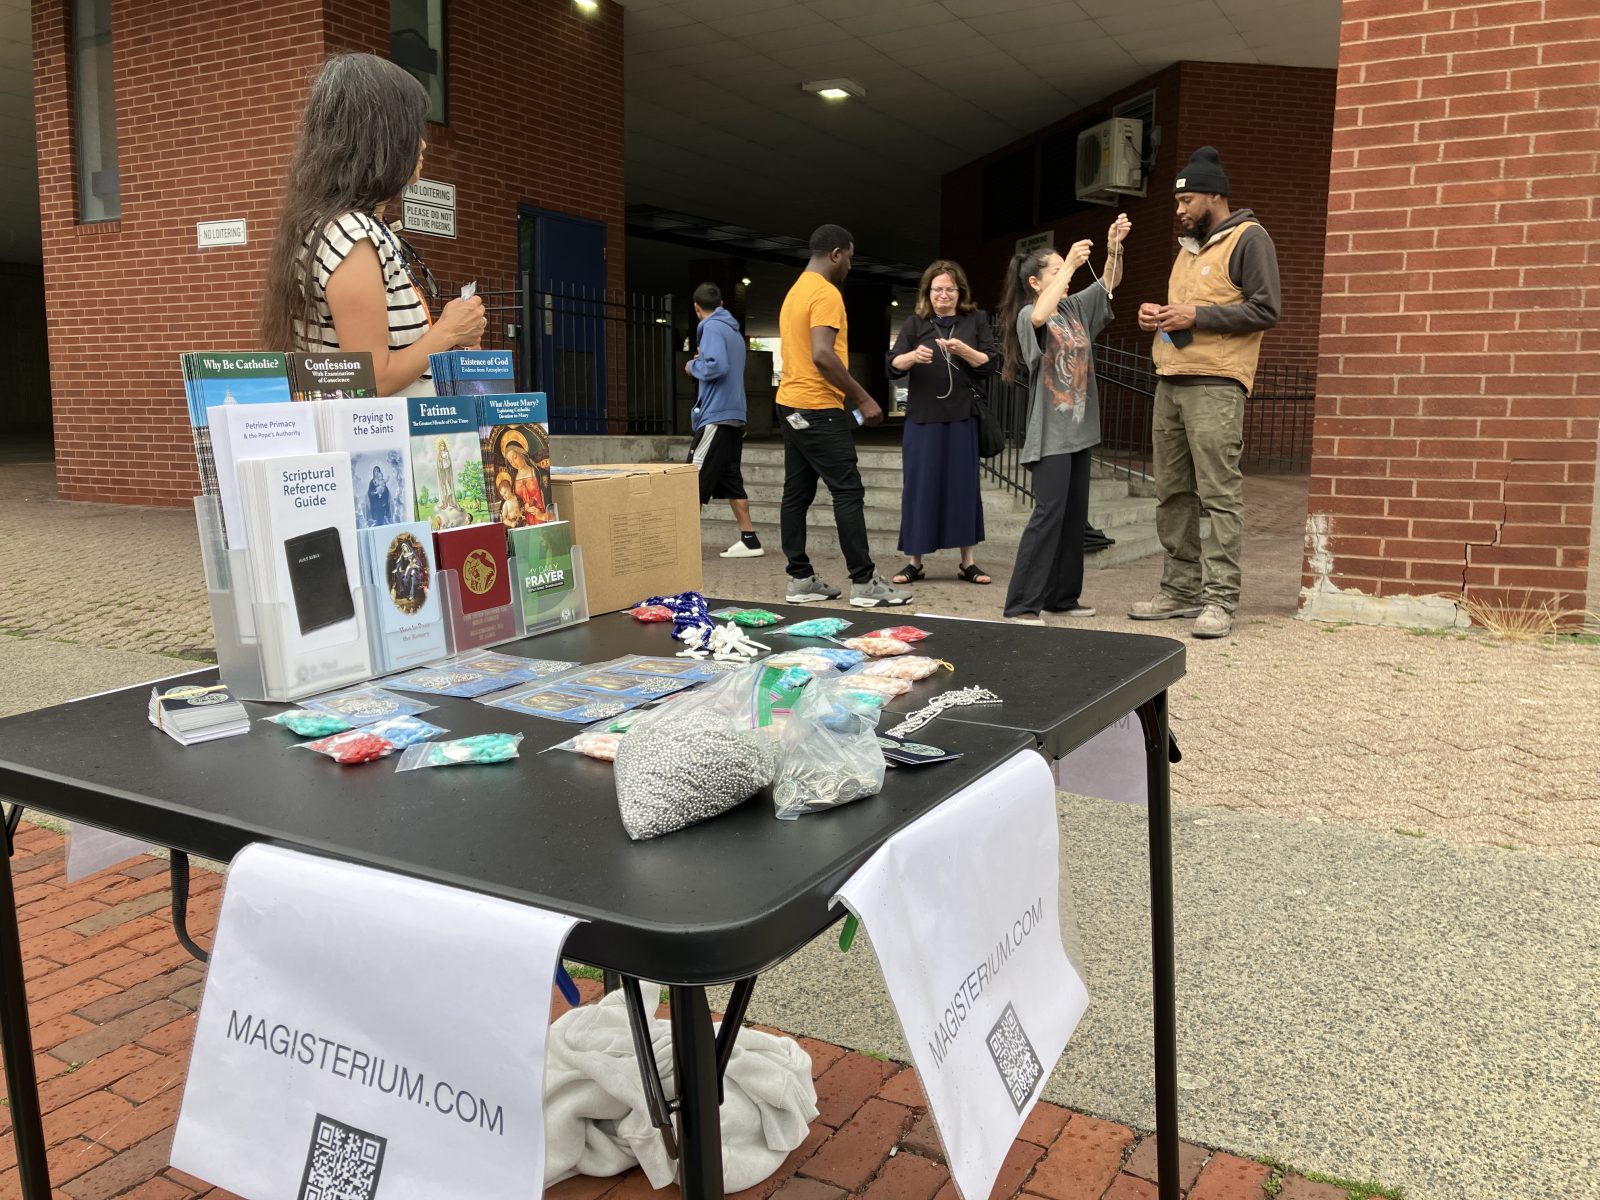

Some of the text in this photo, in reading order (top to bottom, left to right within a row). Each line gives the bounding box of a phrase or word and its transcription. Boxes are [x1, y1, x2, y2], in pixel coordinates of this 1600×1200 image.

[409, 184, 450, 200] NO LOITERING
[406, 206, 452, 221] PLEASE DO NOT
[408, 217, 451, 231] FEED THE PIGEONS
[203, 227, 241, 239] NO LOITERING
[203, 358, 279, 372] Why Be Catholic?
[304, 358, 361, 371] Confession
[459, 356, 509, 365] Existence of God
[419, 403, 457, 417] Fatima
[520, 399, 539, 407] Mary?
[245, 421, 296, 430] Petrine Primacy
[353, 412, 394, 427] Praying to
[258, 431, 275, 439] Pope's
[276, 430, 301, 438] Authority
[354, 424, 394, 435] the Saints
[282, 467, 335, 483] Scriptural
[283, 481, 337, 496] Reference
[294, 495, 327, 508] Guide
[538, 563, 559, 573] DAILY
[525, 570, 564, 588] PRAYER
[928, 896, 1043, 1070] MAGISTERIUM.COM
[226, 1010, 504, 1136] MAGISTERIUM.COM
